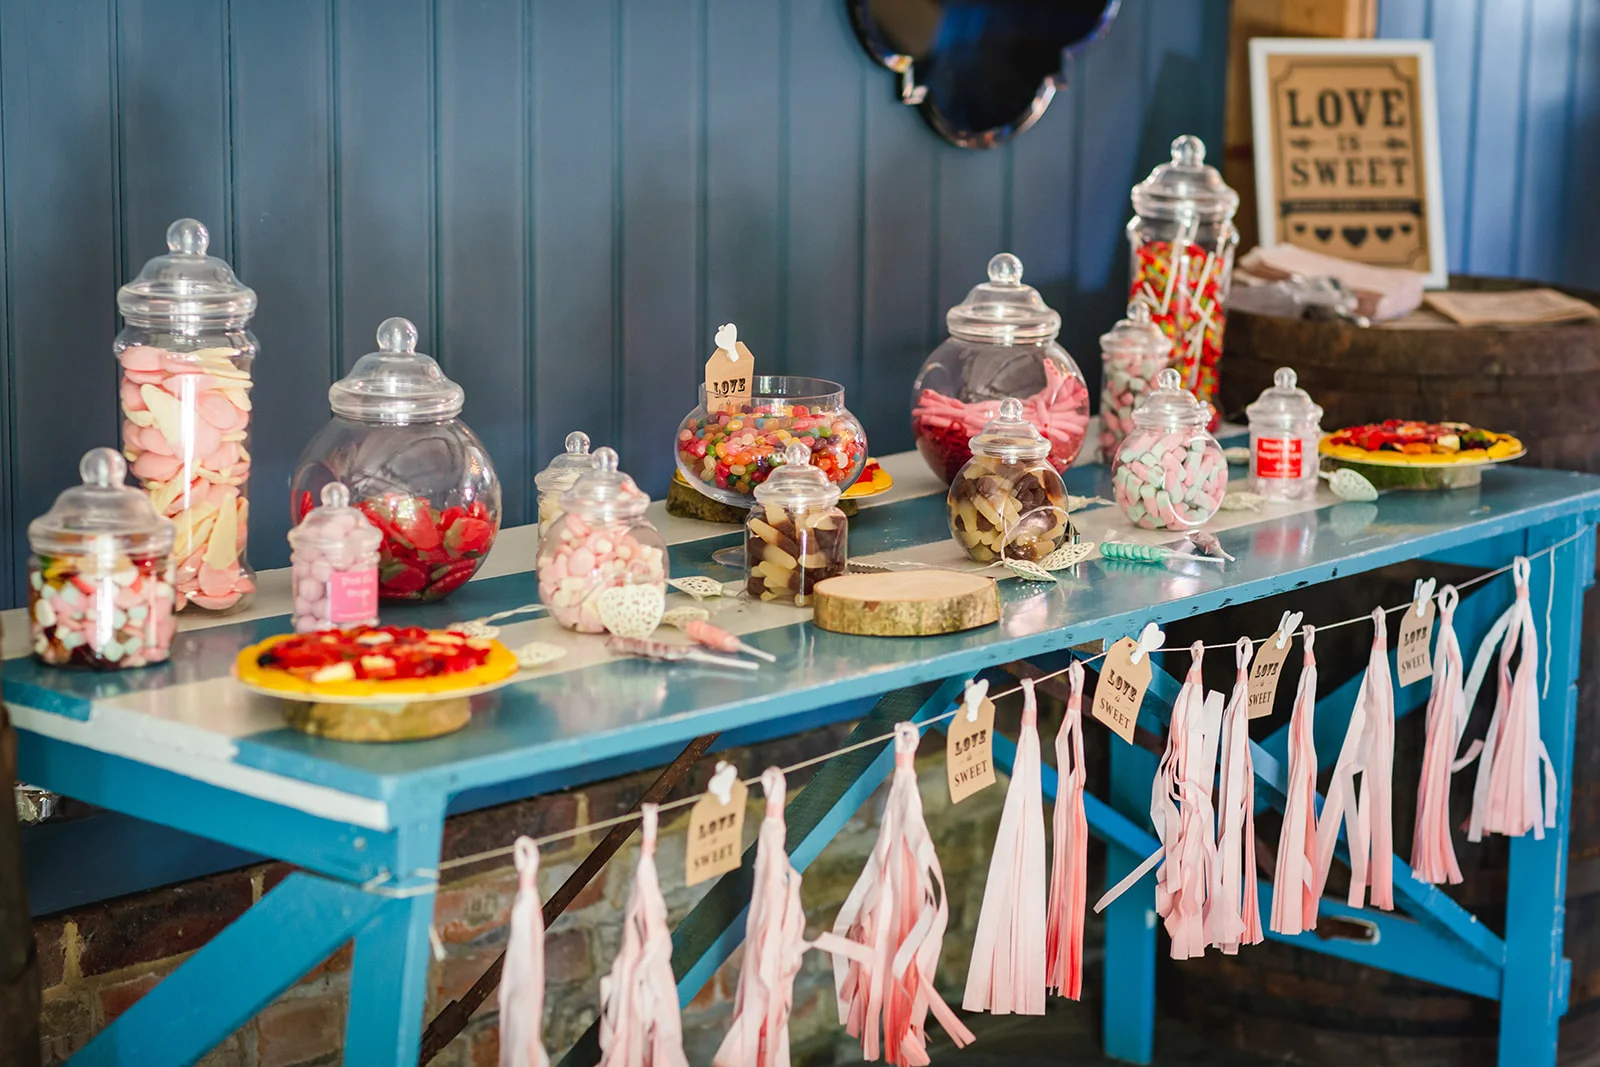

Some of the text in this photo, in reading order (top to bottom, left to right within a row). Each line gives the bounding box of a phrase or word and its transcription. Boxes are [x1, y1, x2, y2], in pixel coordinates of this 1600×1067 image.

[1286, 87, 1405, 128] LOVE
[1290, 156, 1407, 187] SWEET
[713, 377, 746, 398] LOVE
[1403, 625, 1428, 648] LOVE
[1254, 662, 1280, 679] LOVE
[1401, 653, 1425, 674] SWEET
[1107, 667, 1138, 703] LOVE
[1248, 691, 1272, 707] SWEET
[1099, 697, 1130, 729] SWEET
[953, 728, 987, 756] LOVE
[953, 759, 988, 787] SWEET
[698, 812, 737, 840] LOVE
